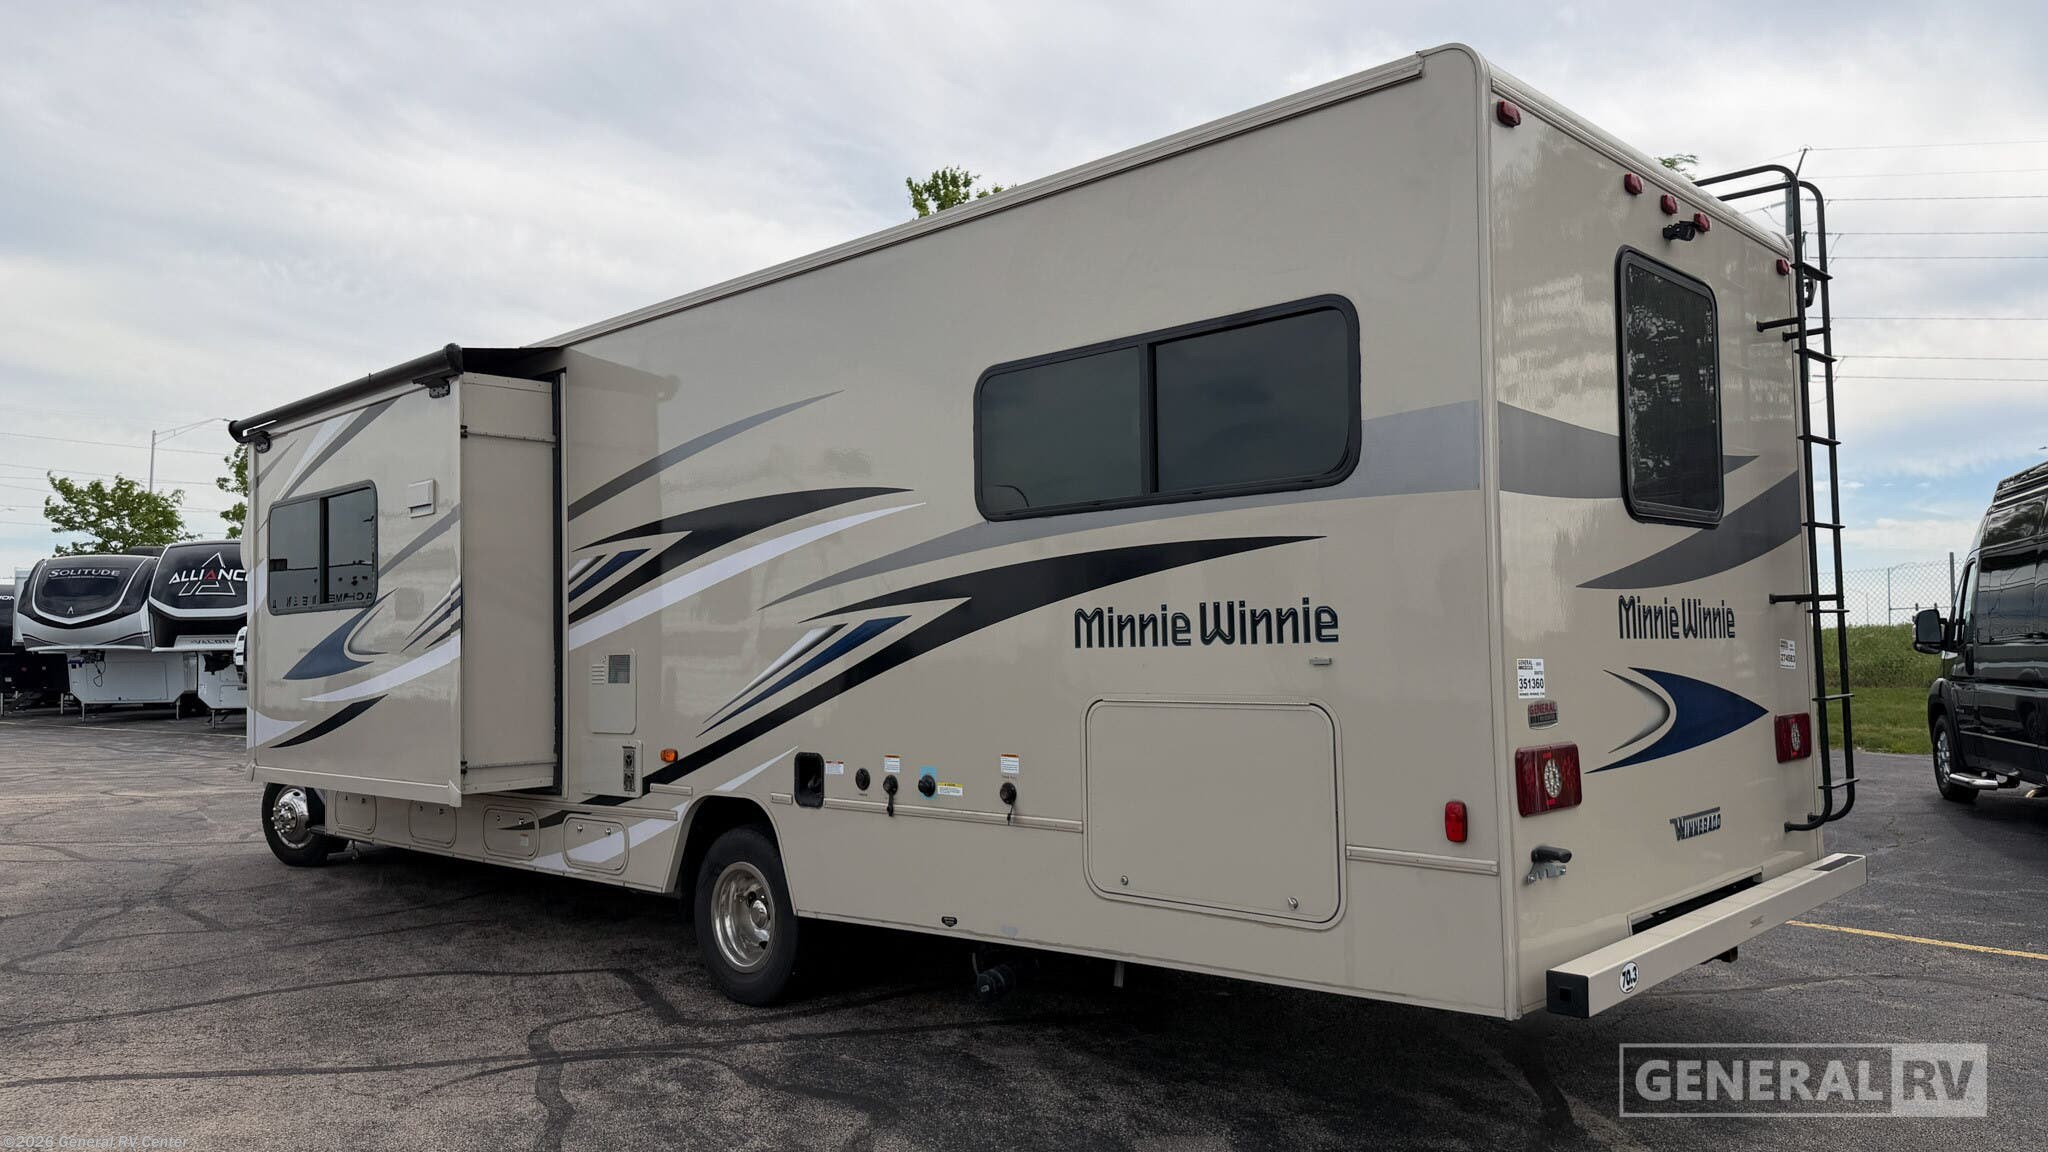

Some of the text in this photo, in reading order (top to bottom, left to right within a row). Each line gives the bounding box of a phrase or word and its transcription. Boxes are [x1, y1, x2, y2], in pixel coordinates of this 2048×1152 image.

[48, 568, 121, 578] SOLITUDE
[168, 568, 248, 585] ALLIANC
[1074, 596, 1339, 649] Minnie Winnie
[1617, 594, 1736, 640] Minnie Winnie
[1518, 677, 1545, 690] 351360
